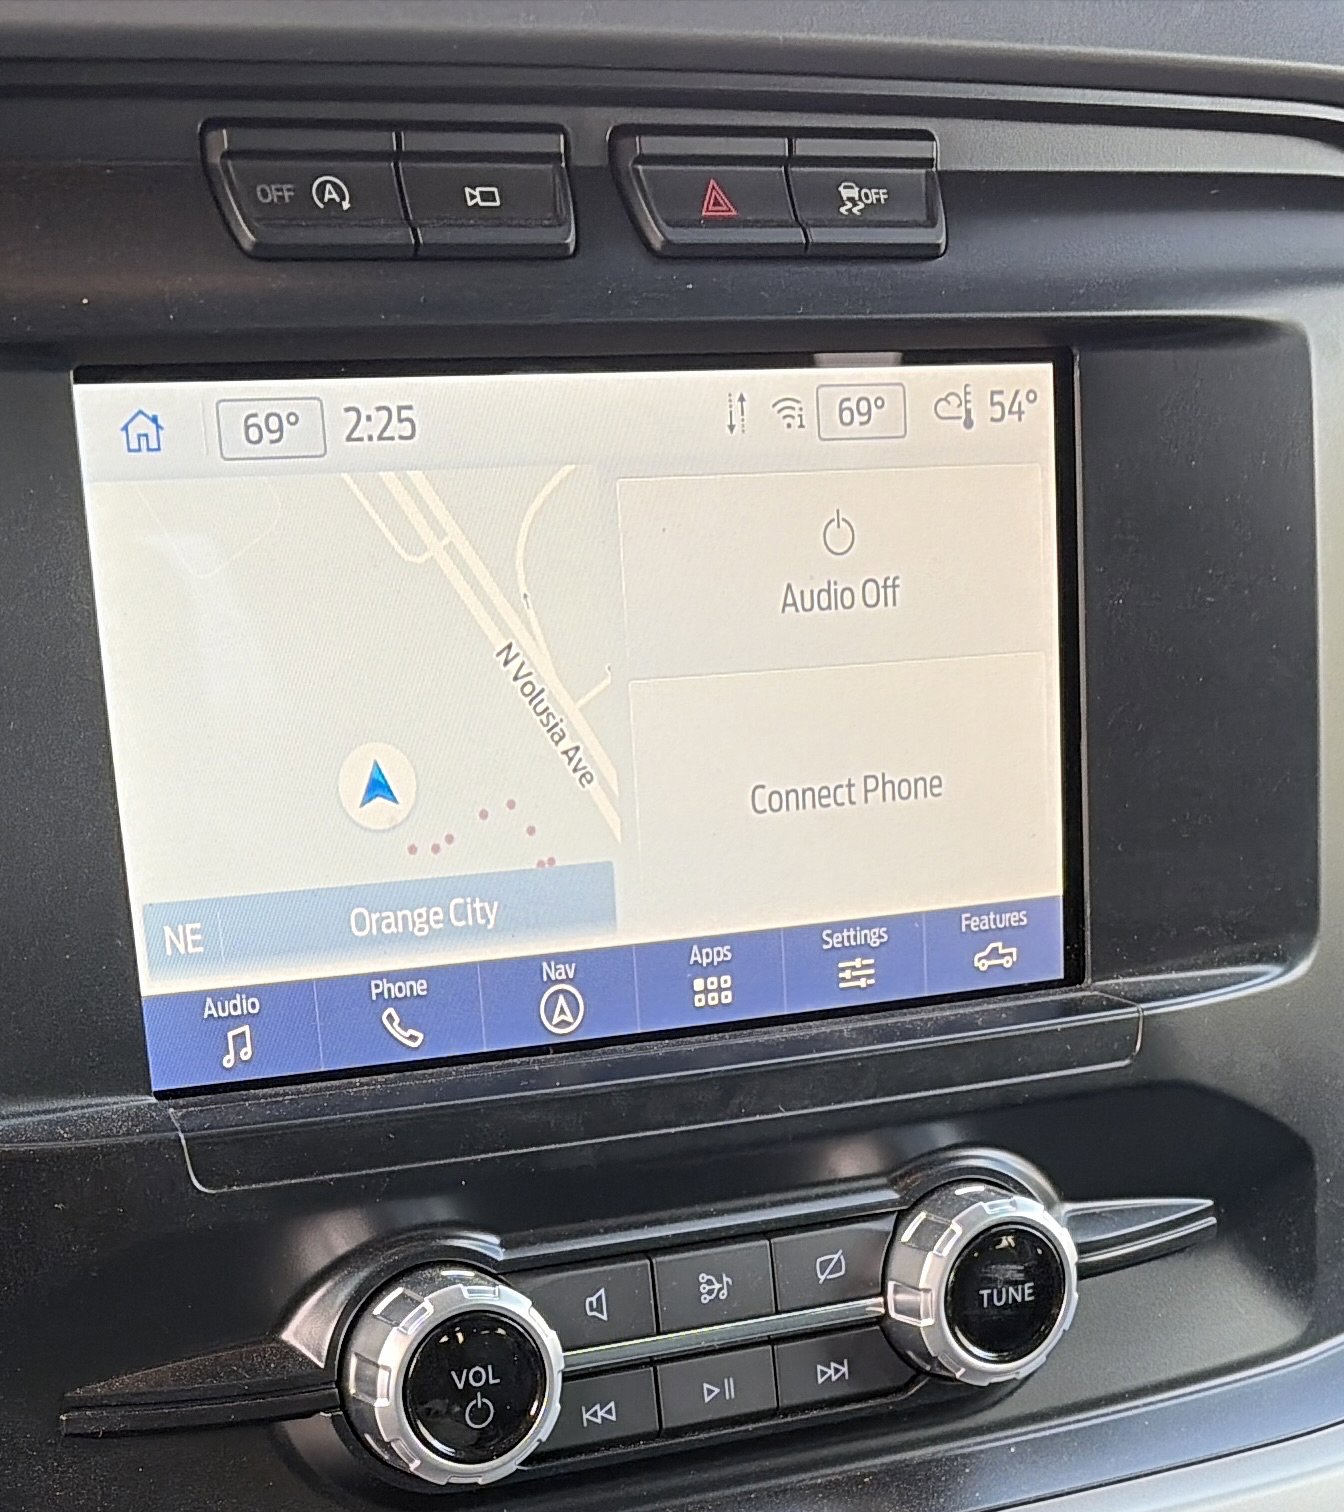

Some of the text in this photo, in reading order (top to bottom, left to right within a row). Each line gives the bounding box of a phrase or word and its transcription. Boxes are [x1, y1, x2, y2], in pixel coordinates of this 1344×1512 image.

[256, 183, 295, 203] OFF
[860, 187, 889, 205] OFF
[342, 403, 417, 443] 2:25
[780, 575, 901, 615] Audio Off
[495, 641, 595, 789] N Volusia Ave
[750, 771, 943, 815] Connect Phone
[349, 897, 499, 938] Orange City
[960, 908, 1029, 933] Features
[163, 921, 205, 956] NE
[821, 924, 889, 950] Settings
[689, 943, 733, 967] Apps
[541, 960, 577, 982] Nav
[370, 976, 428, 1001] Phone
[203, 994, 261, 1020] Audio
[978, 1281, 1036, 1309] TUNE
[450, 1364, 502, 1391] VOL
